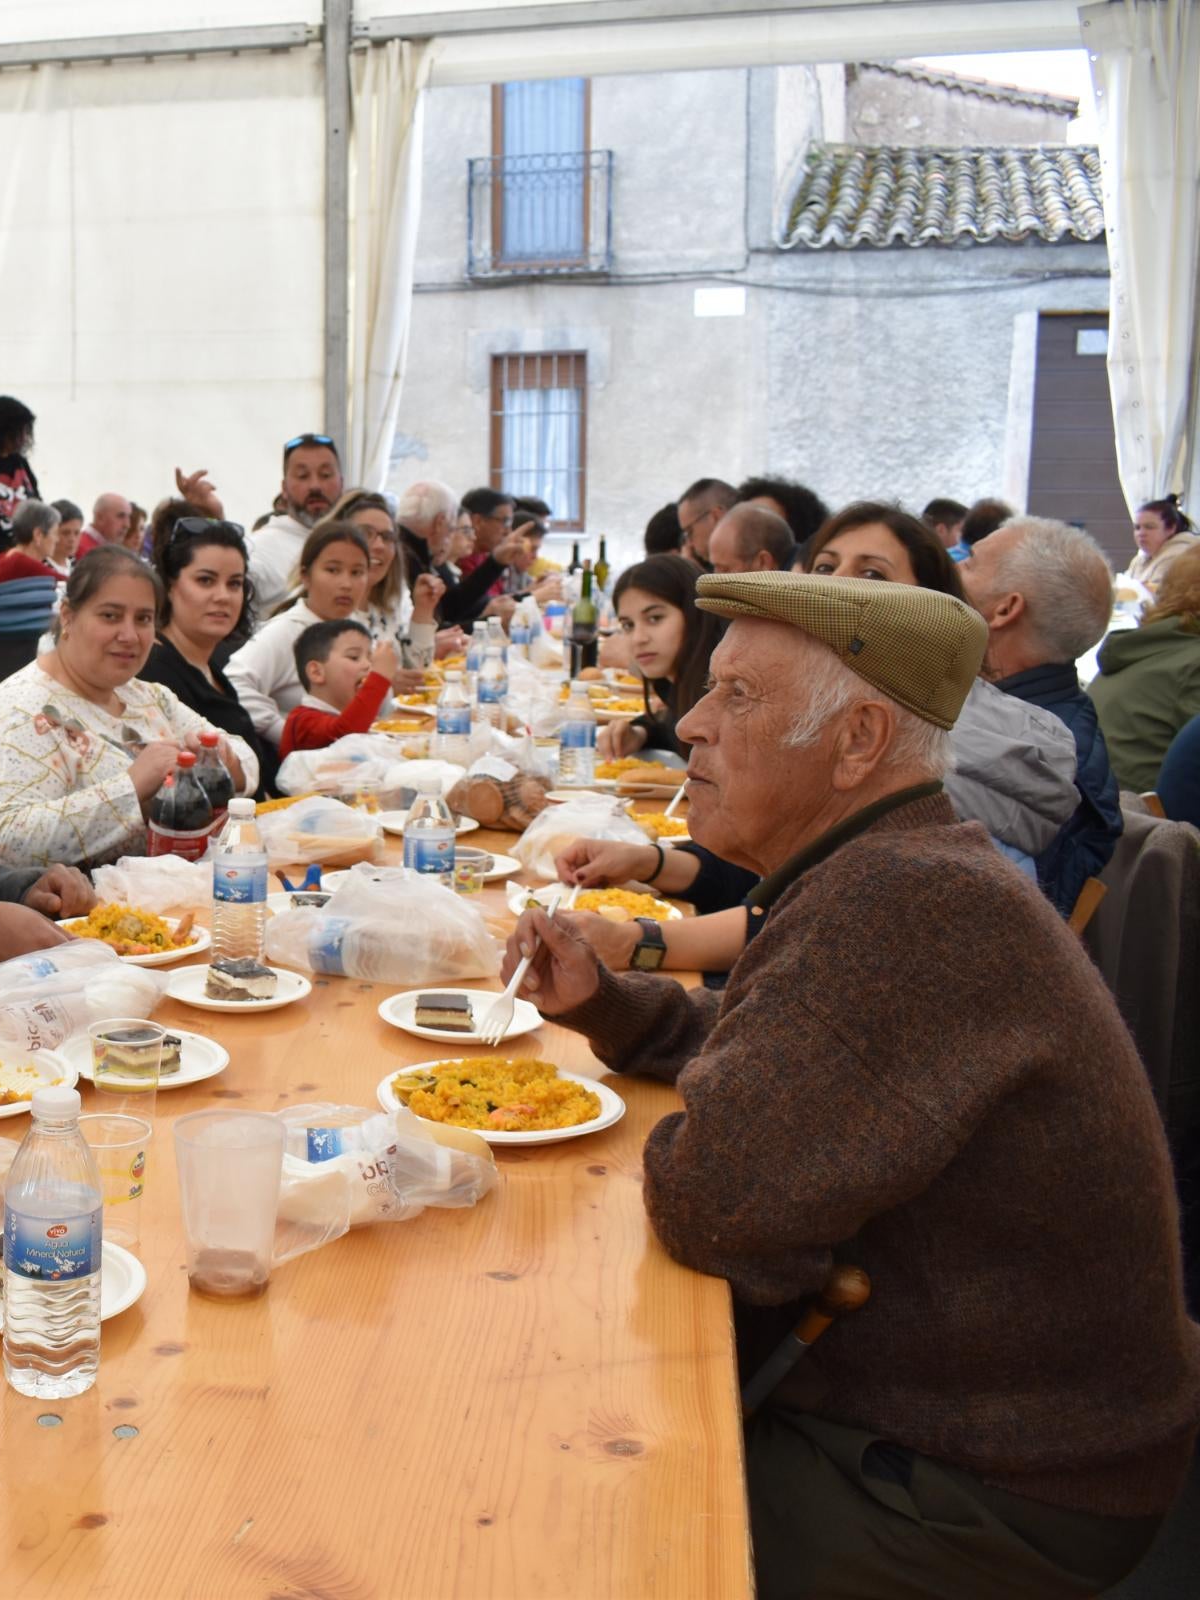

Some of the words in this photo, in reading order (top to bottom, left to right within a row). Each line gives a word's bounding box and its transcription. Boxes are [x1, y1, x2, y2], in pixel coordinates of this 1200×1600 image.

[44, 1240, 69, 1249] Agua
[26, 1248, 54, 1258] Mineral
[56, 1247, 86, 1258] Natural
